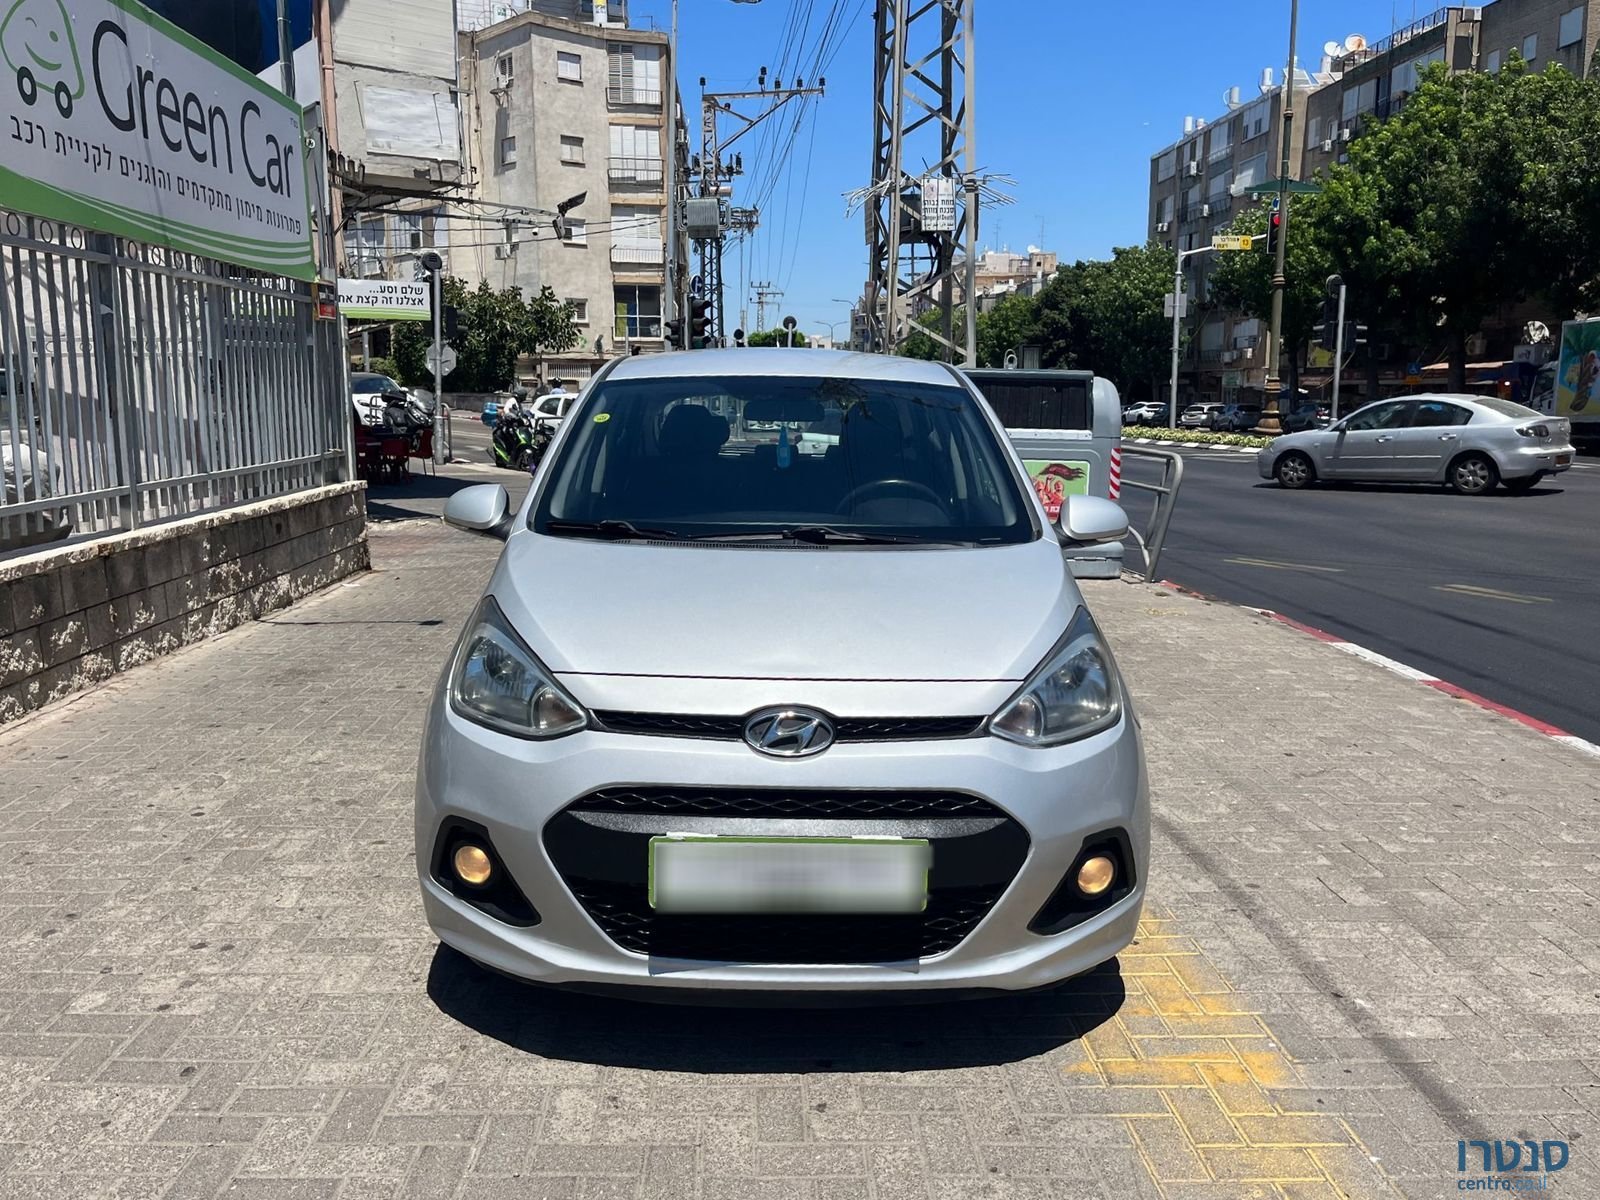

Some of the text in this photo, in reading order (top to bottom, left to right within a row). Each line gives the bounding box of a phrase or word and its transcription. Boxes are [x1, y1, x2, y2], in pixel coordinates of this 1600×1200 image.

[92, 19, 294, 198] Green Car
[10, 115, 302, 236] פתרונות מימון מתקדמים והוגנים לקניית רכב
[401, 285, 424, 295] שלם
[356, 295, 379, 306] קצת
[381, 296, 393, 305] זה
[396, 296, 424, 306] אצלנו
